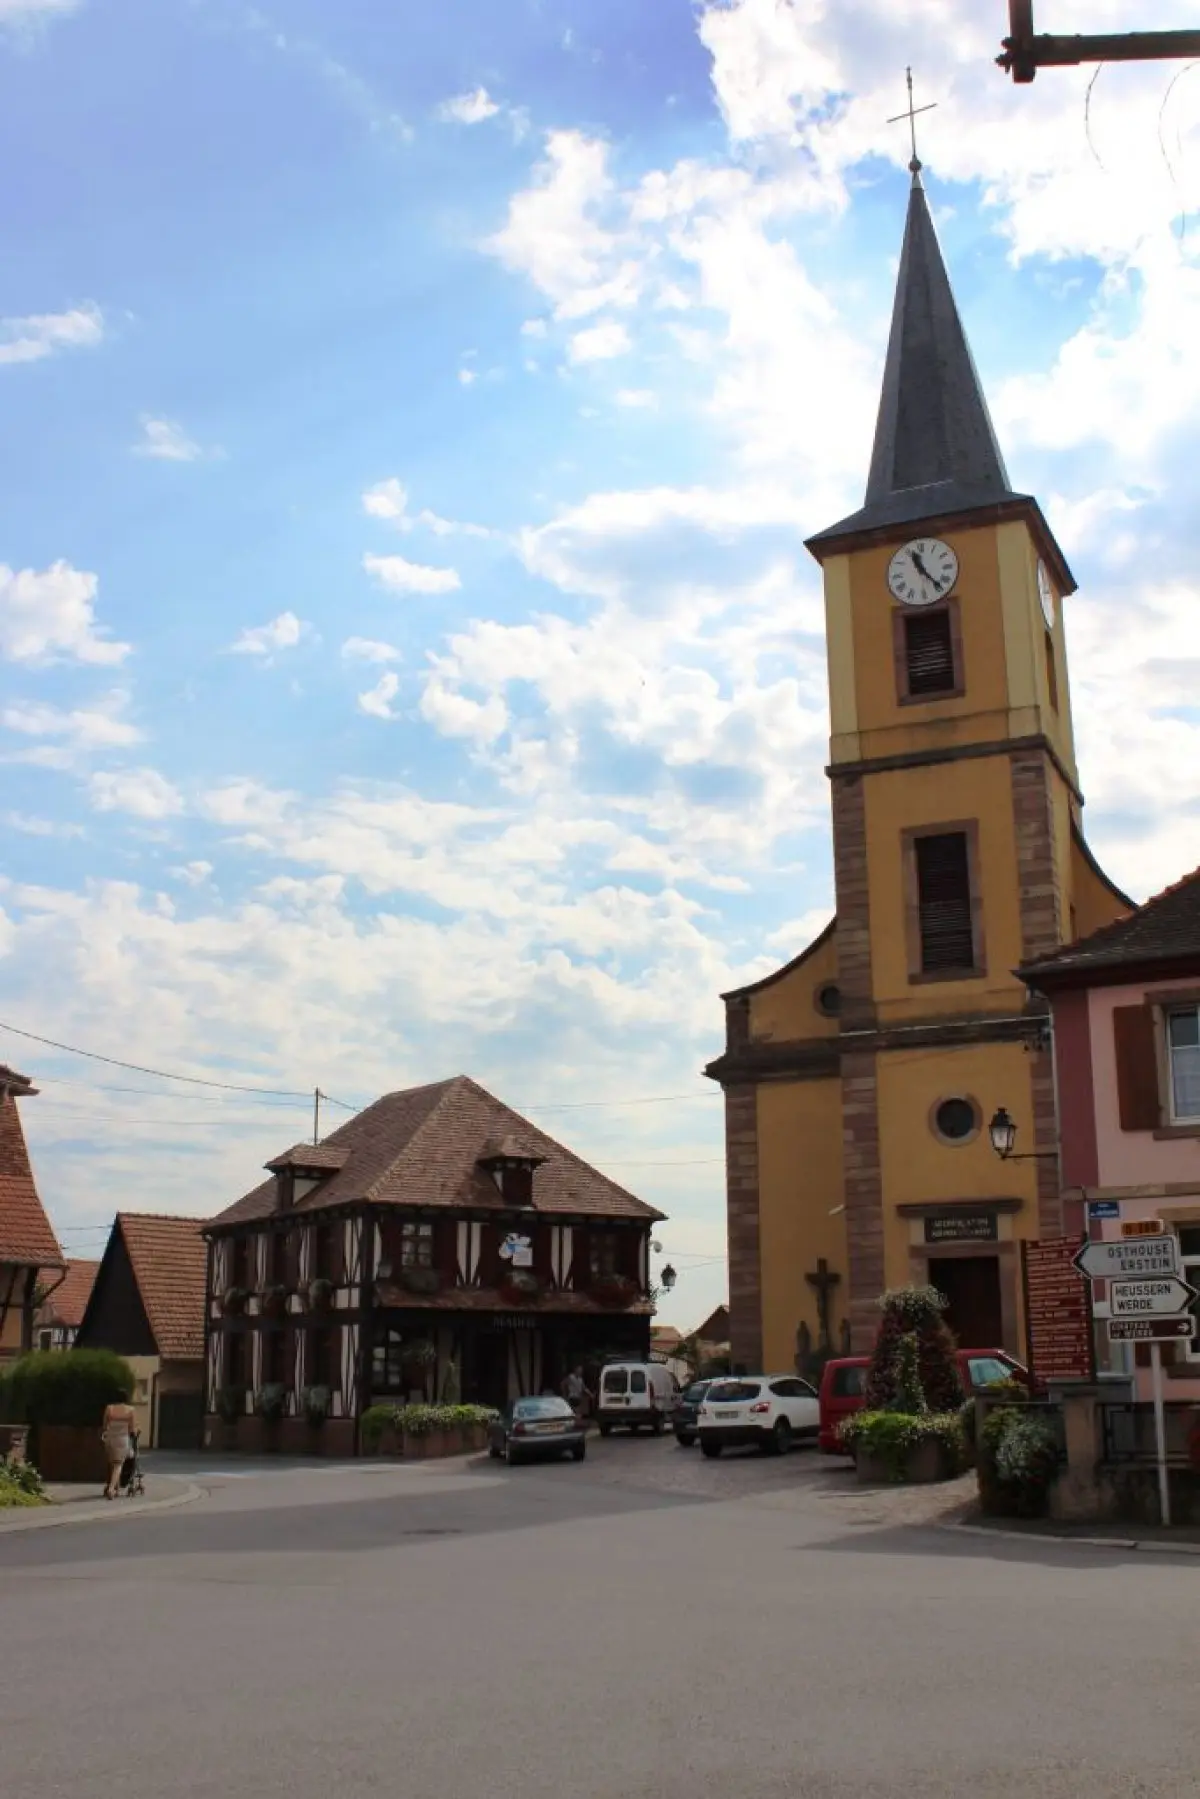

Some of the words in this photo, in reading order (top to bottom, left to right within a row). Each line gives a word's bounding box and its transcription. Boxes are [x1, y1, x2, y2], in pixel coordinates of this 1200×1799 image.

[1107, 1243, 1169, 1258] OSTHOUSE
[1120, 1258, 1170, 1271] ERSTEIN
[1115, 1284, 1171, 1296] HEUSSERN
[1117, 1298, 1153, 1310] WERDE
